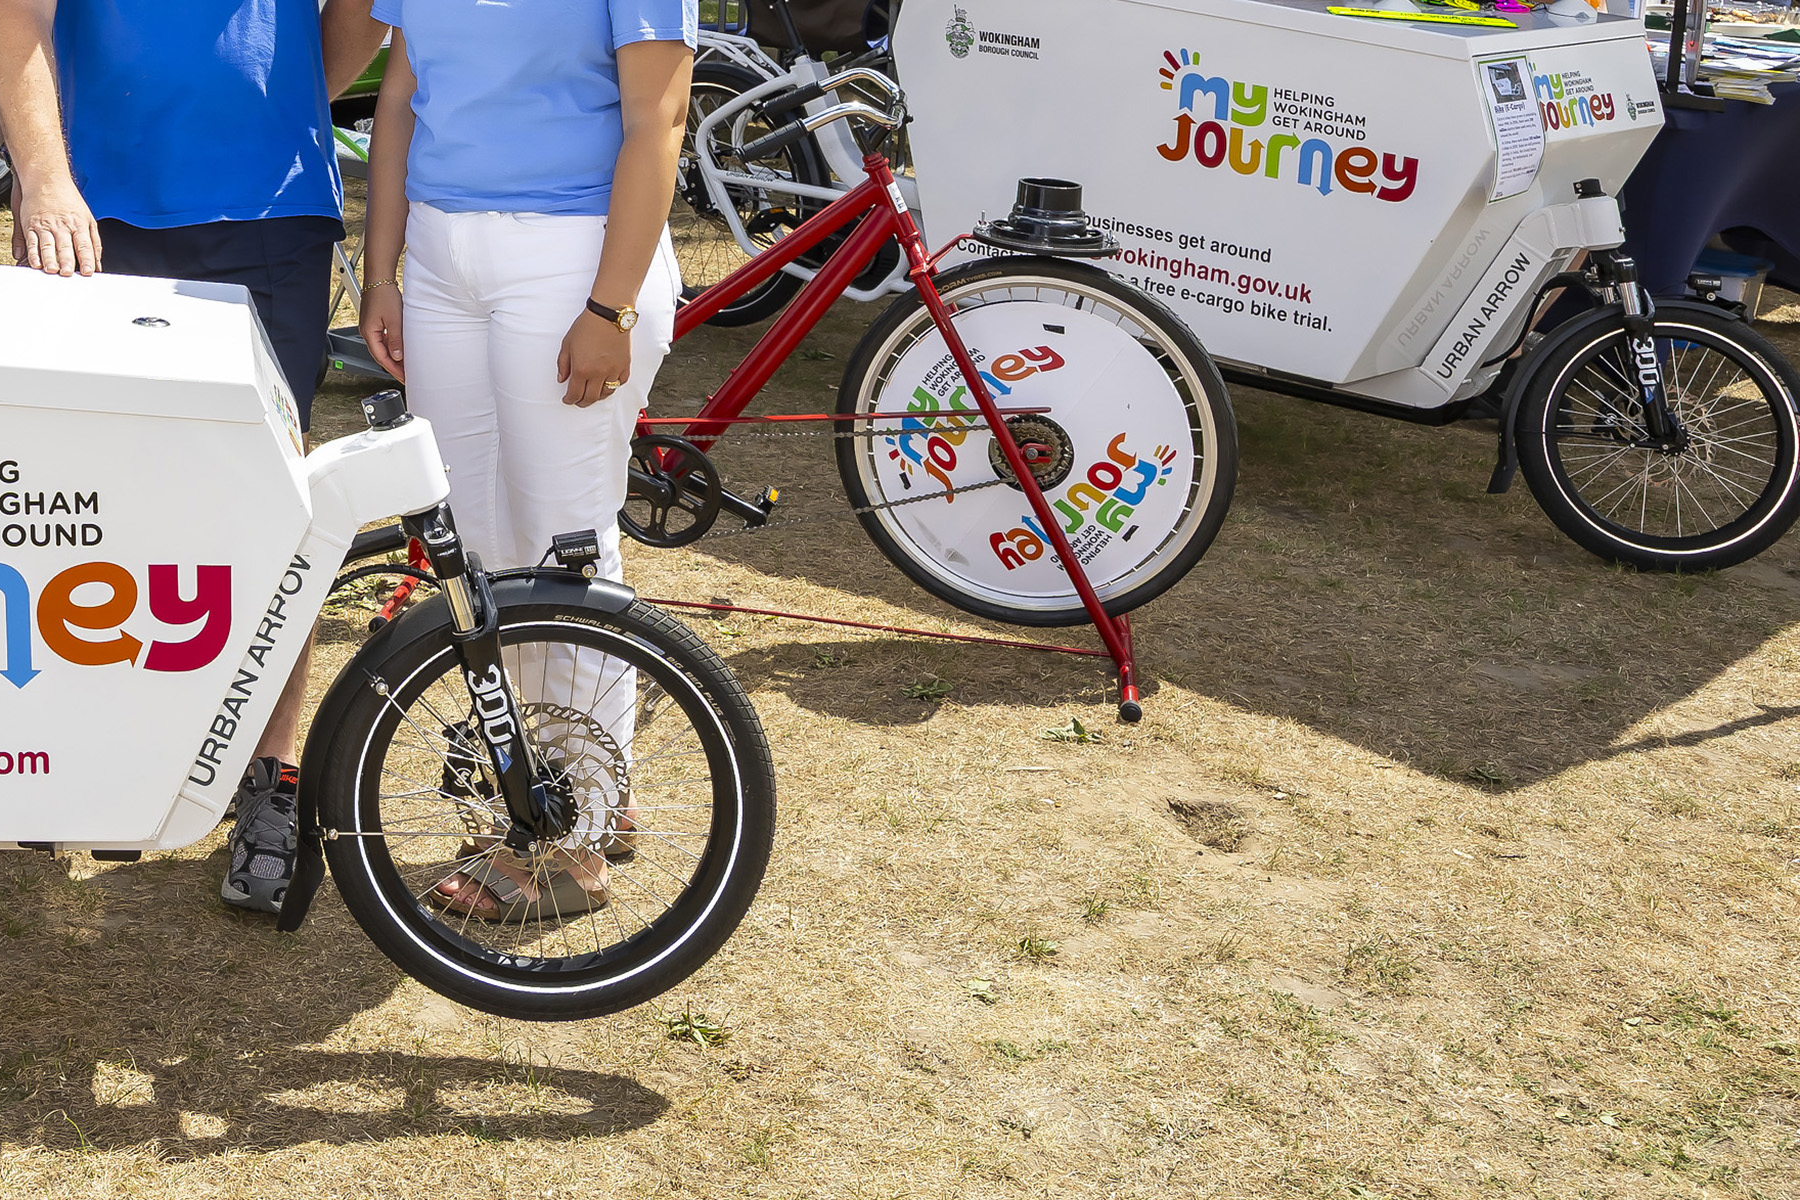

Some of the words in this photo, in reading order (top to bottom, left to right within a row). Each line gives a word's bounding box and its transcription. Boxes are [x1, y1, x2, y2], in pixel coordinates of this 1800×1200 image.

[979, 31, 1040, 49] WOKINGHAM
[979, 44, 1010, 56] BOROUGH
[1011, 49, 1040, 60] COUNCIL
[1179, 72, 1268, 127] my
[1273, 87, 1335, 108] HELPING
[1534, 73, 1565, 100] my
[1272, 115, 1300, 130] GET
[1303, 122, 1366, 141] AROUND
[1273, 102, 1366, 127] WOKINGHAM
[1084, 214, 1173, 243] businesses
[1178, 232, 1206, 250] get
[1210, 240, 1272, 263] around
[1090, 248, 1312, 304] wokingham.gov.uk
[1480, 252, 1531, 322] ARROW
[1144, 276, 1175, 296] free
[1181, 287, 1244, 314] e-cargo
[1250, 300, 1287, 321] bike
[1293, 310, 1332, 333] trial.
[921, 353, 954, 386] HELPING
[929, 347, 980, 392] WOKINGM
[1436, 318, 1486, 380] URBAN
[1632, 336, 1660, 385] 300
[937, 383, 953, 398] GET
[949, 353, 986, 384] ARND
[1050, 538, 1083, 564] AROND
[1057, 530, 1105, 571] WOKINGM
[1080, 525, 1096, 539] GET
[1081, 534, 1113, 566] HELPING
[554, 613, 622, 634] SCHWALBE
[467, 664, 517, 744] 300
[666, 656, 684, 670] BIG
[704, 692, 724, 717] PLUS
[188, 668, 259, 787] URBAN
